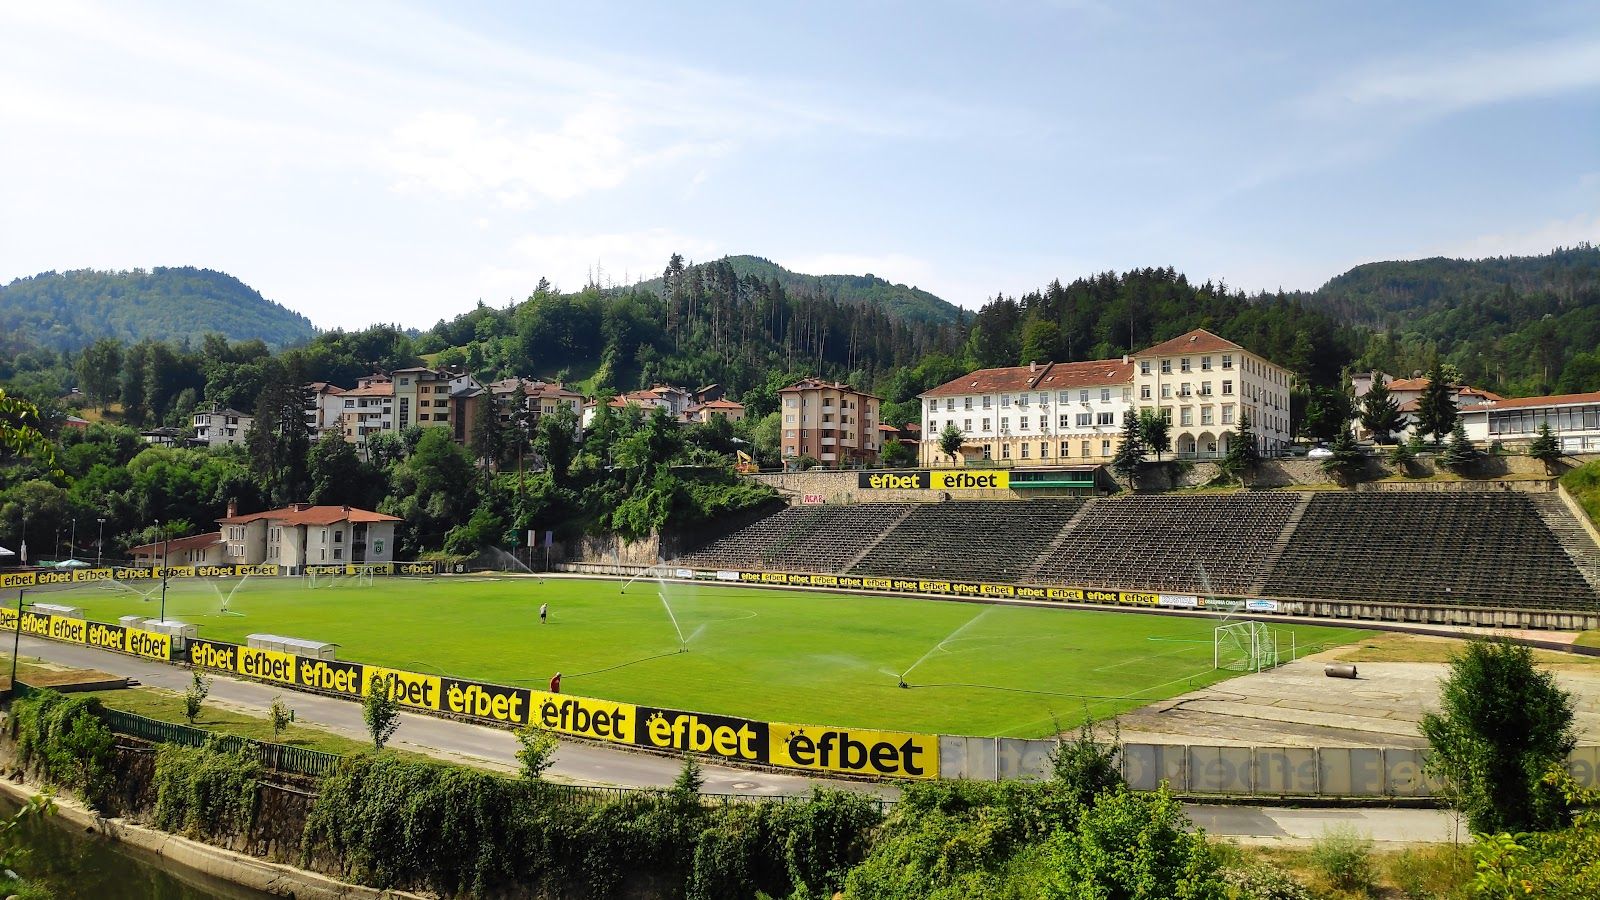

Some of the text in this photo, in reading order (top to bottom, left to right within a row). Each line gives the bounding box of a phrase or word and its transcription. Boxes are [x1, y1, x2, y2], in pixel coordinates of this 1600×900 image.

[870, 474, 919, 488] efbet
[944, 474, 997, 487] efbet
[117, 568, 150, 579] efbet
[199, 565, 232, 575] efbet
[240, 564, 274, 574] efbet
[401, 564, 433, 574] efbet
[4, 575, 33, 585] efbet
[38, 573, 70, 583] efbet
[77, 570, 108, 580] efbet
[741, 571, 760, 580] efbet
[765, 573, 783, 581] efbet
[788, 574, 809, 583] efbet
[814, 575, 834, 583] efbet
[840, 577, 860, 586] efbet
[866, 578, 888, 587] efbet
[894, 580, 917, 589] efbet
[924, 582, 946, 590] efbet
[953, 583, 978, 592] efbet
[985, 585, 1009, 594] efbet
[1017, 587, 1044, 596] efbet
[1052, 589, 1079, 598] efbet
[1087, 591, 1116, 600] efbet
[1125, 593, 1154, 602] efbet
[0, 609, 16, 628] bet
[21, 613, 49, 634] efbet
[54, 620, 83, 641] efbet
[89, 625, 123, 649] efbet
[130, 632, 166, 657] efbet
[191, 643, 234, 671] efbet
[243, 651, 290, 680] efbet
[301, 659, 358, 693] efbet
[447, 684, 523, 723] efbet
[540, 698, 626, 739] efbet
[647, 711, 757, 758] efbet
[786, 729, 924, 776] efbet
